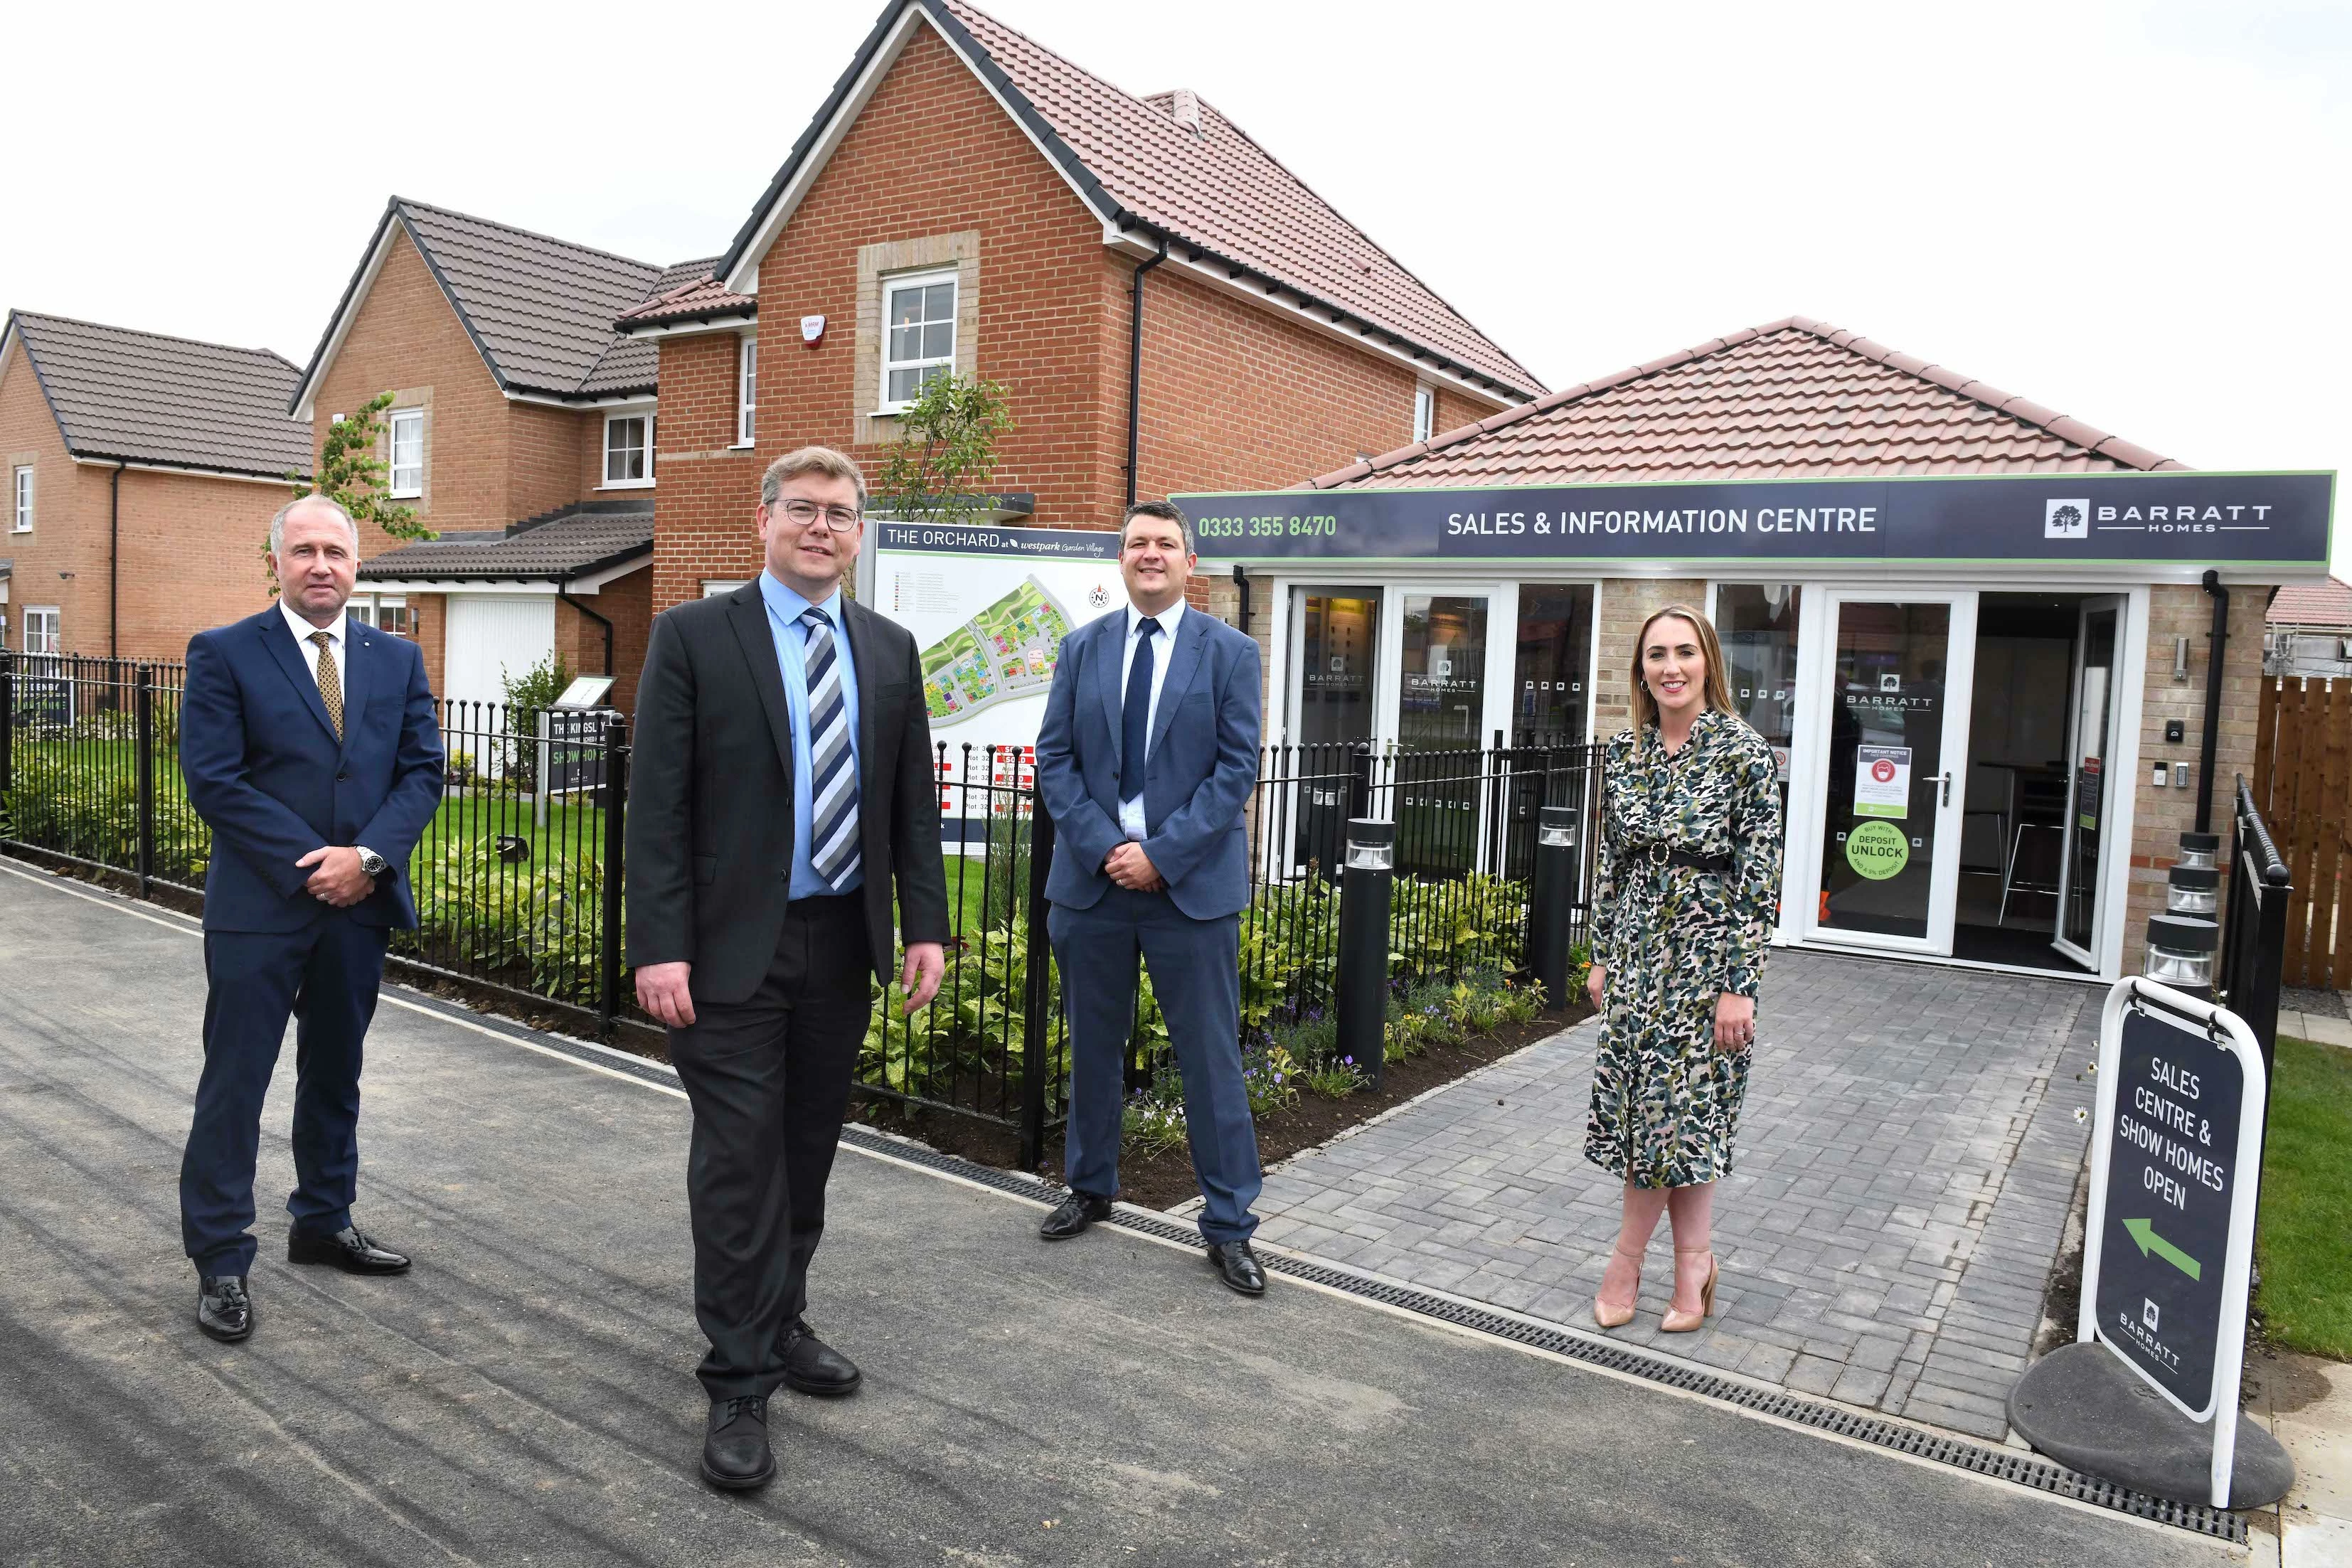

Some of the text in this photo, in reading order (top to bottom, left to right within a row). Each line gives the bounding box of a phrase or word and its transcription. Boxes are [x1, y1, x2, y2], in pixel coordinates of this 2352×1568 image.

[1447, 507, 1877, 535] SALES & INFORMATION CENTRE
[2098, 506, 2272, 521] BARRATT
[1198, 516, 1336, 537] 0333 355 8470
[2148, 524, 2216, 533] HOMES
[887, 529, 918, 544] THE
[923, 530, 999, 548] ORCHARD
[1021, 541, 1060, 552] westpark
[1061, 543, 1085, 552] Garden
[1085, 543, 1104, 558] Village
[1411, 678, 1476, 688] BARRATT
[1846, 695, 1932, 707] BARRATT
[570, 721, 606, 734] KIGSLY
[1859, 836, 1897, 845] DEPOSIT
[1851, 845, 1903, 858] UNLOCK
[1853, 858, 1863, 869] AND
[1878, 860, 1900, 875] DEPOSIT
[2151, 1057, 2200, 1100] SALES
[2135, 1086, 2211, 1147] CENTRE &
[2119, 1114, 2224, 1192] SHOW HOMES
[2144, 1166, 2186, 1211] OPEN
[2120, 1312, 2180, 1366] BARRATT
[2136, 1338, 2159, 1361] HOMES
